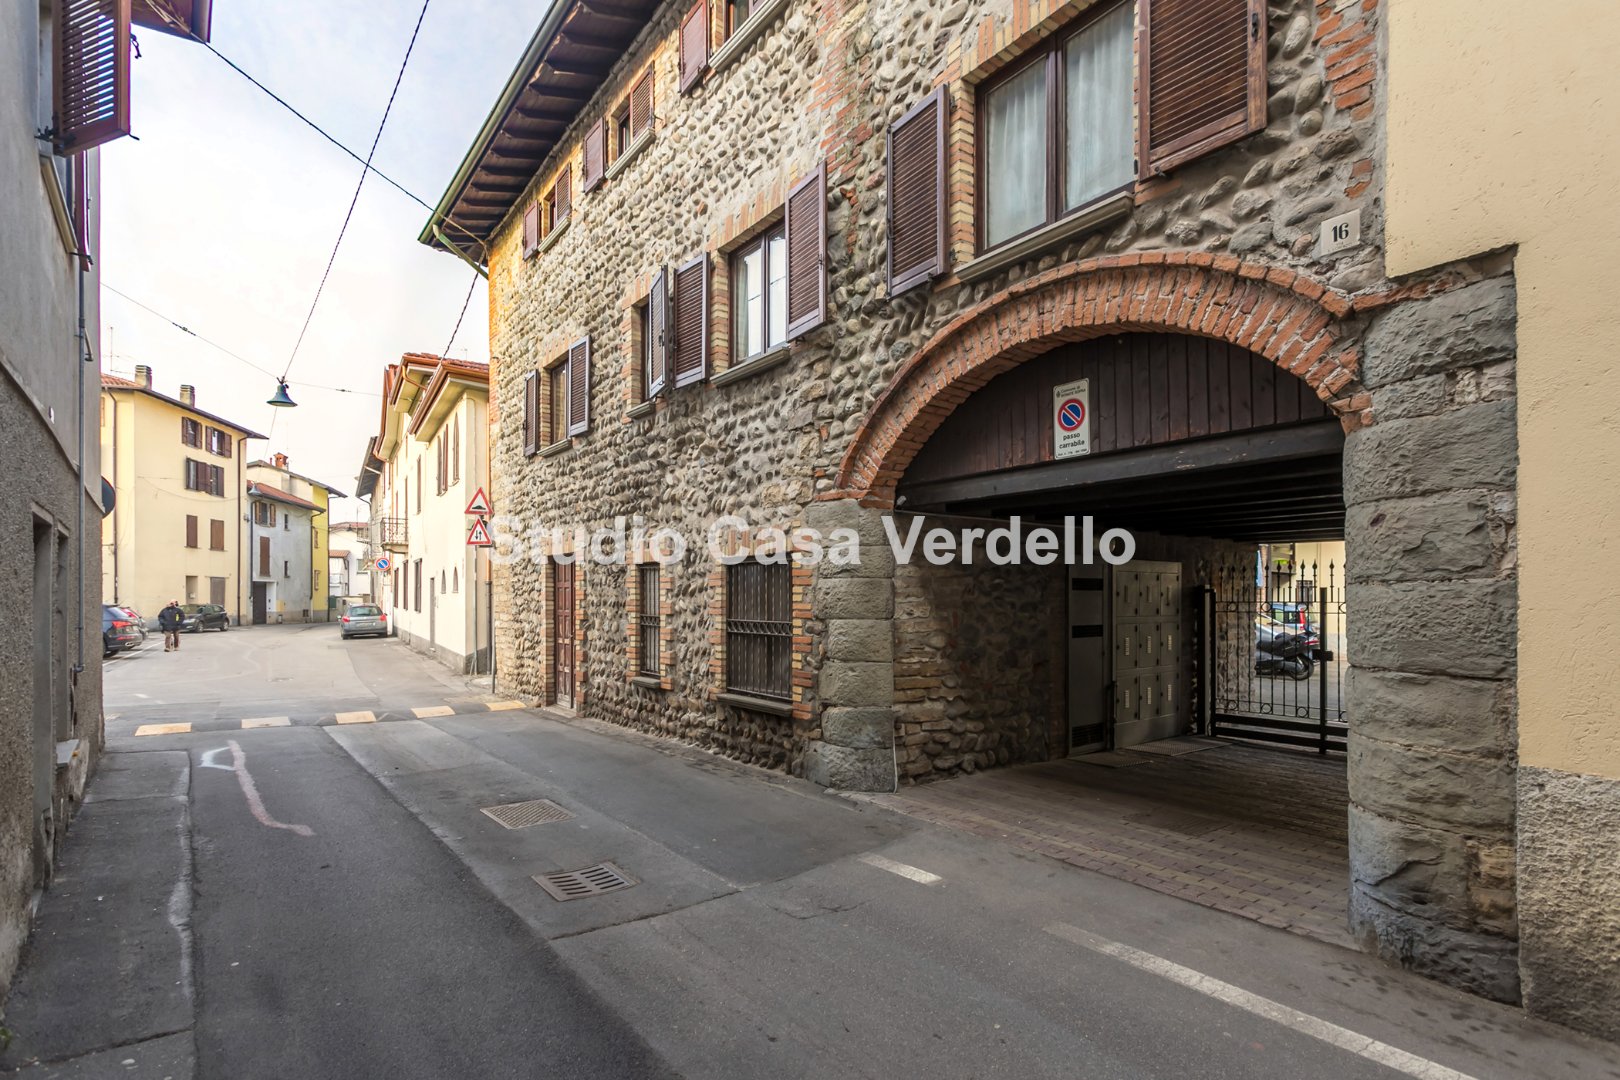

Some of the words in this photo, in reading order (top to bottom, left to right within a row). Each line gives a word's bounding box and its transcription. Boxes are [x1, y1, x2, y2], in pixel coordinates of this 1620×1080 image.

[1331, 222, 1349, 242] 16
[1063, 433, 1080, 441] passo
[1059, 440, 1085, 449] carrabile
